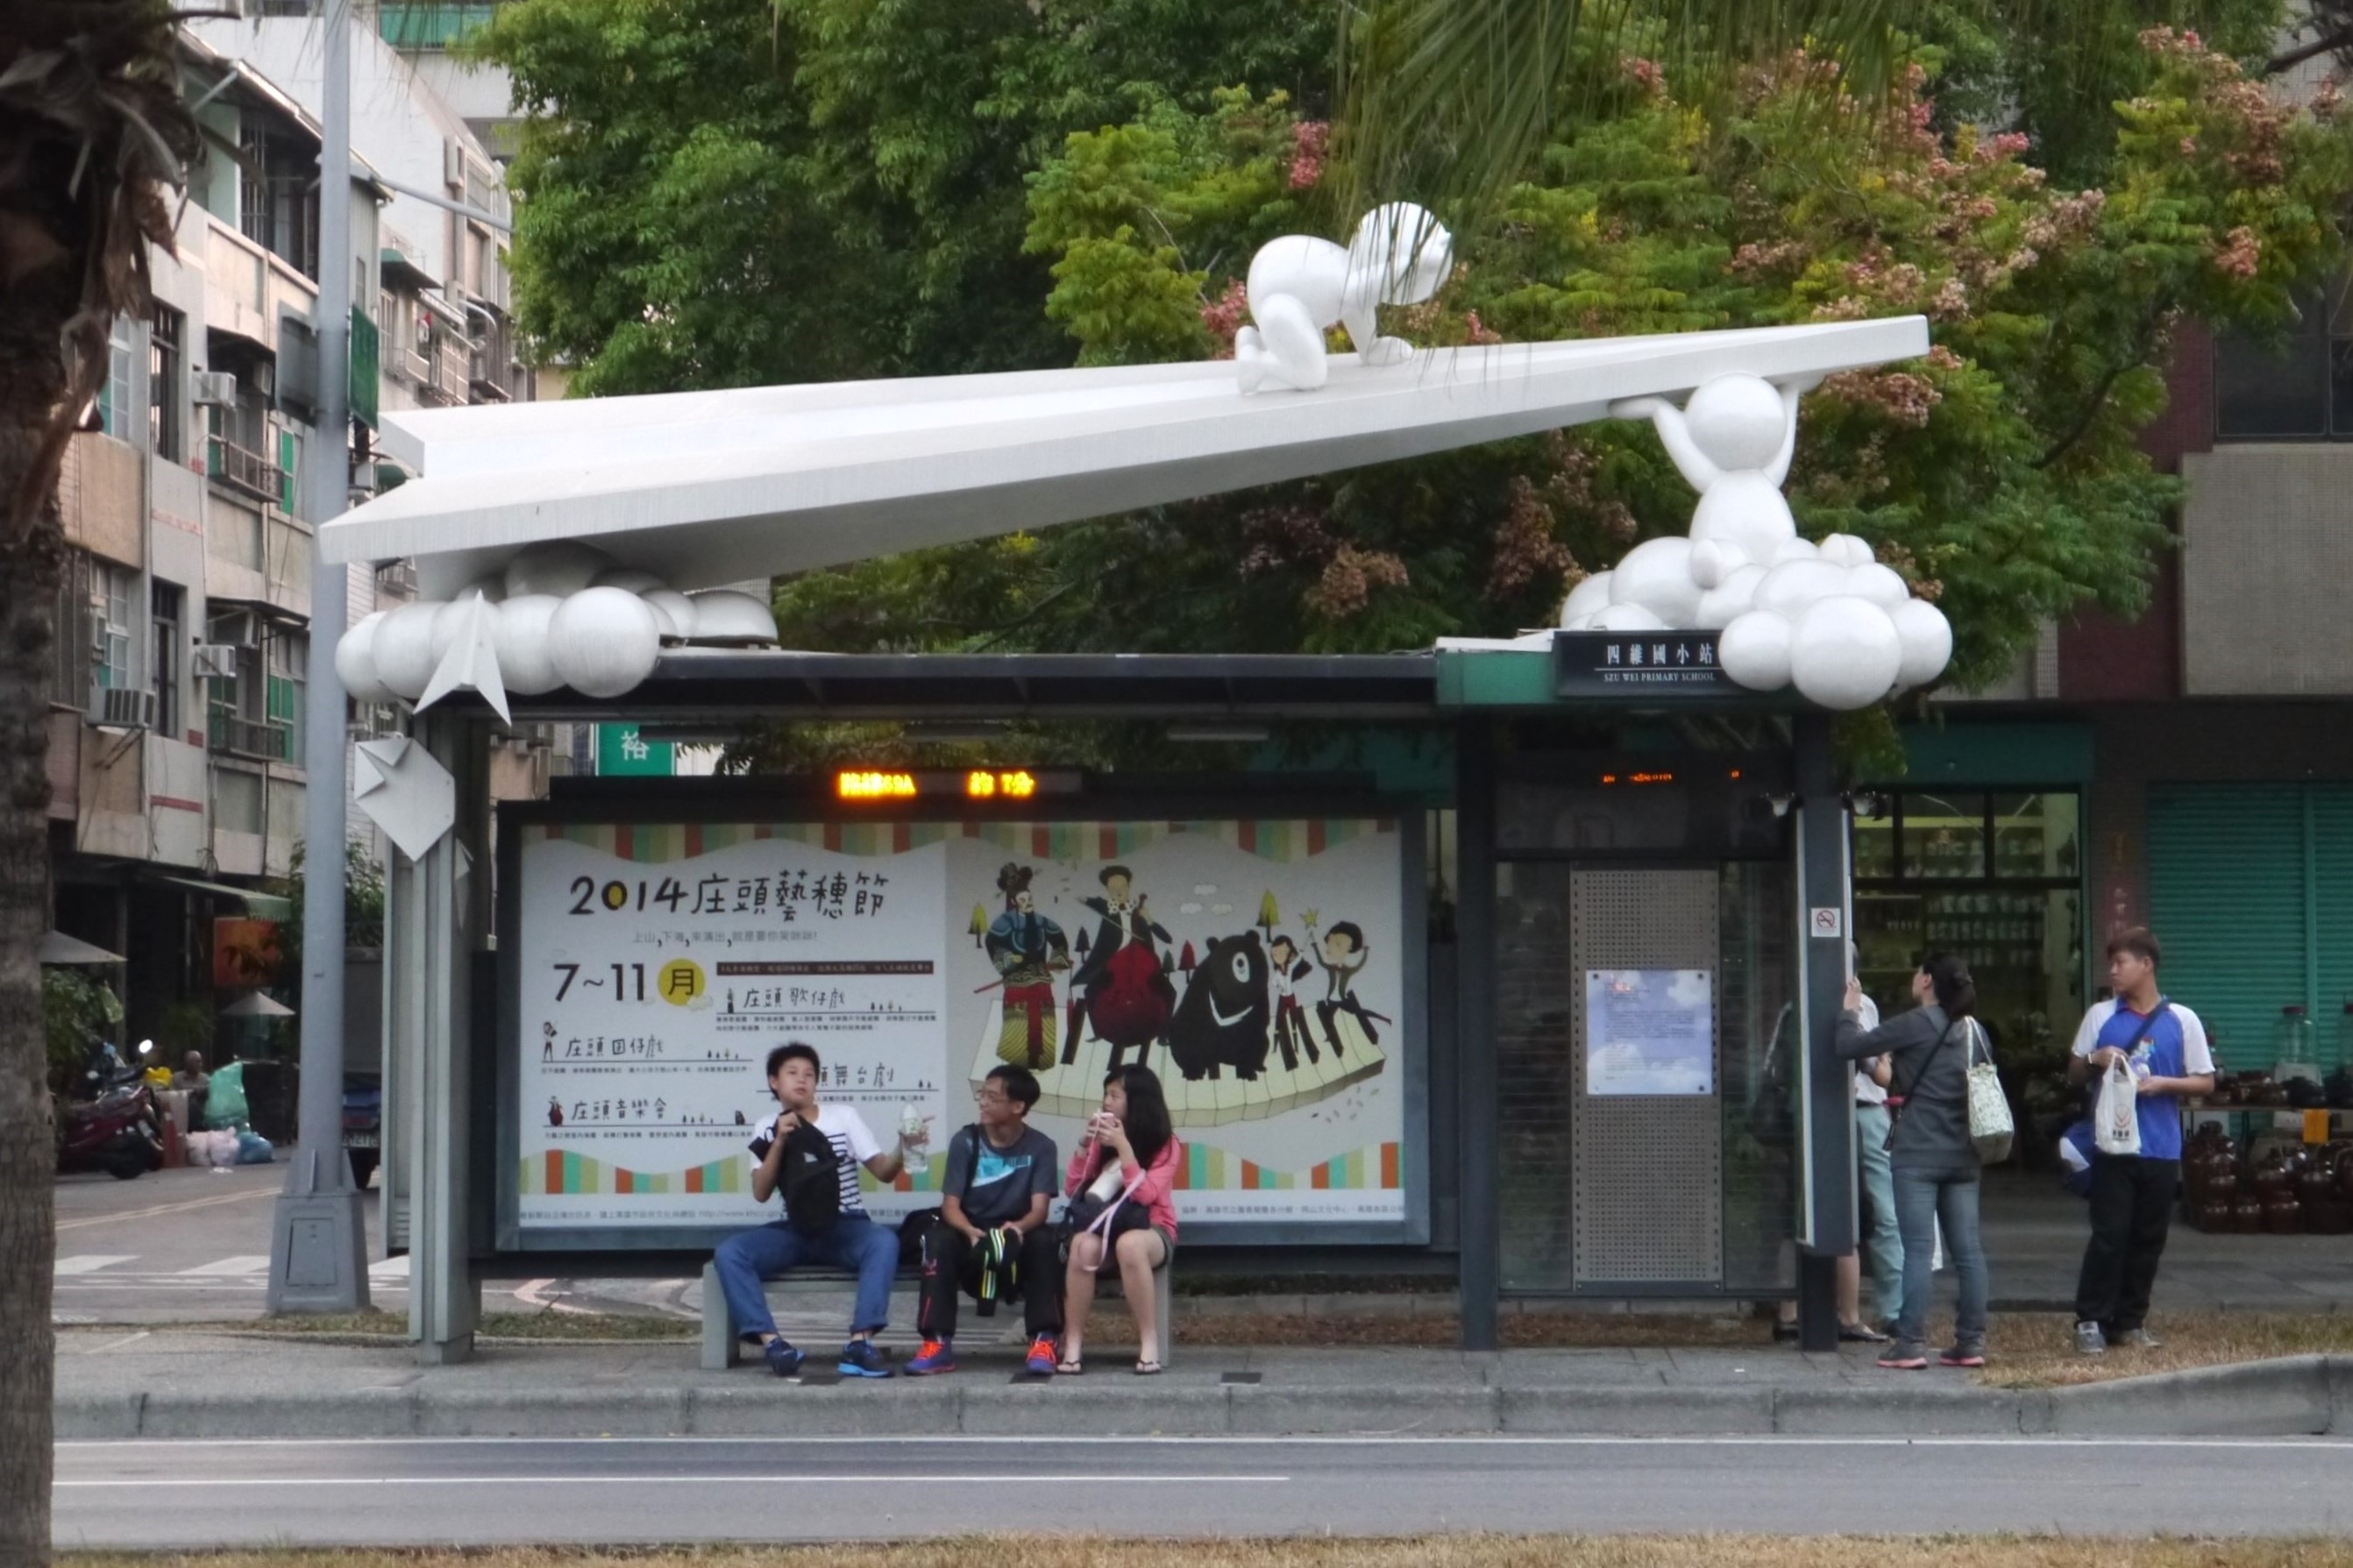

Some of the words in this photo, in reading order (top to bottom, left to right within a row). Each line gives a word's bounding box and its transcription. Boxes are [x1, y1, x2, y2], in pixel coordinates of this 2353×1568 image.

[1606, 642, 1714, 666] 四維國小站
[1603, 673, 1621, 683] SZU
[1623, 673, 1639, 683] WEI
[1641, 672, 1679, 683] PRIMARY
[1681, 671, 1716, 681] SCHOOL
